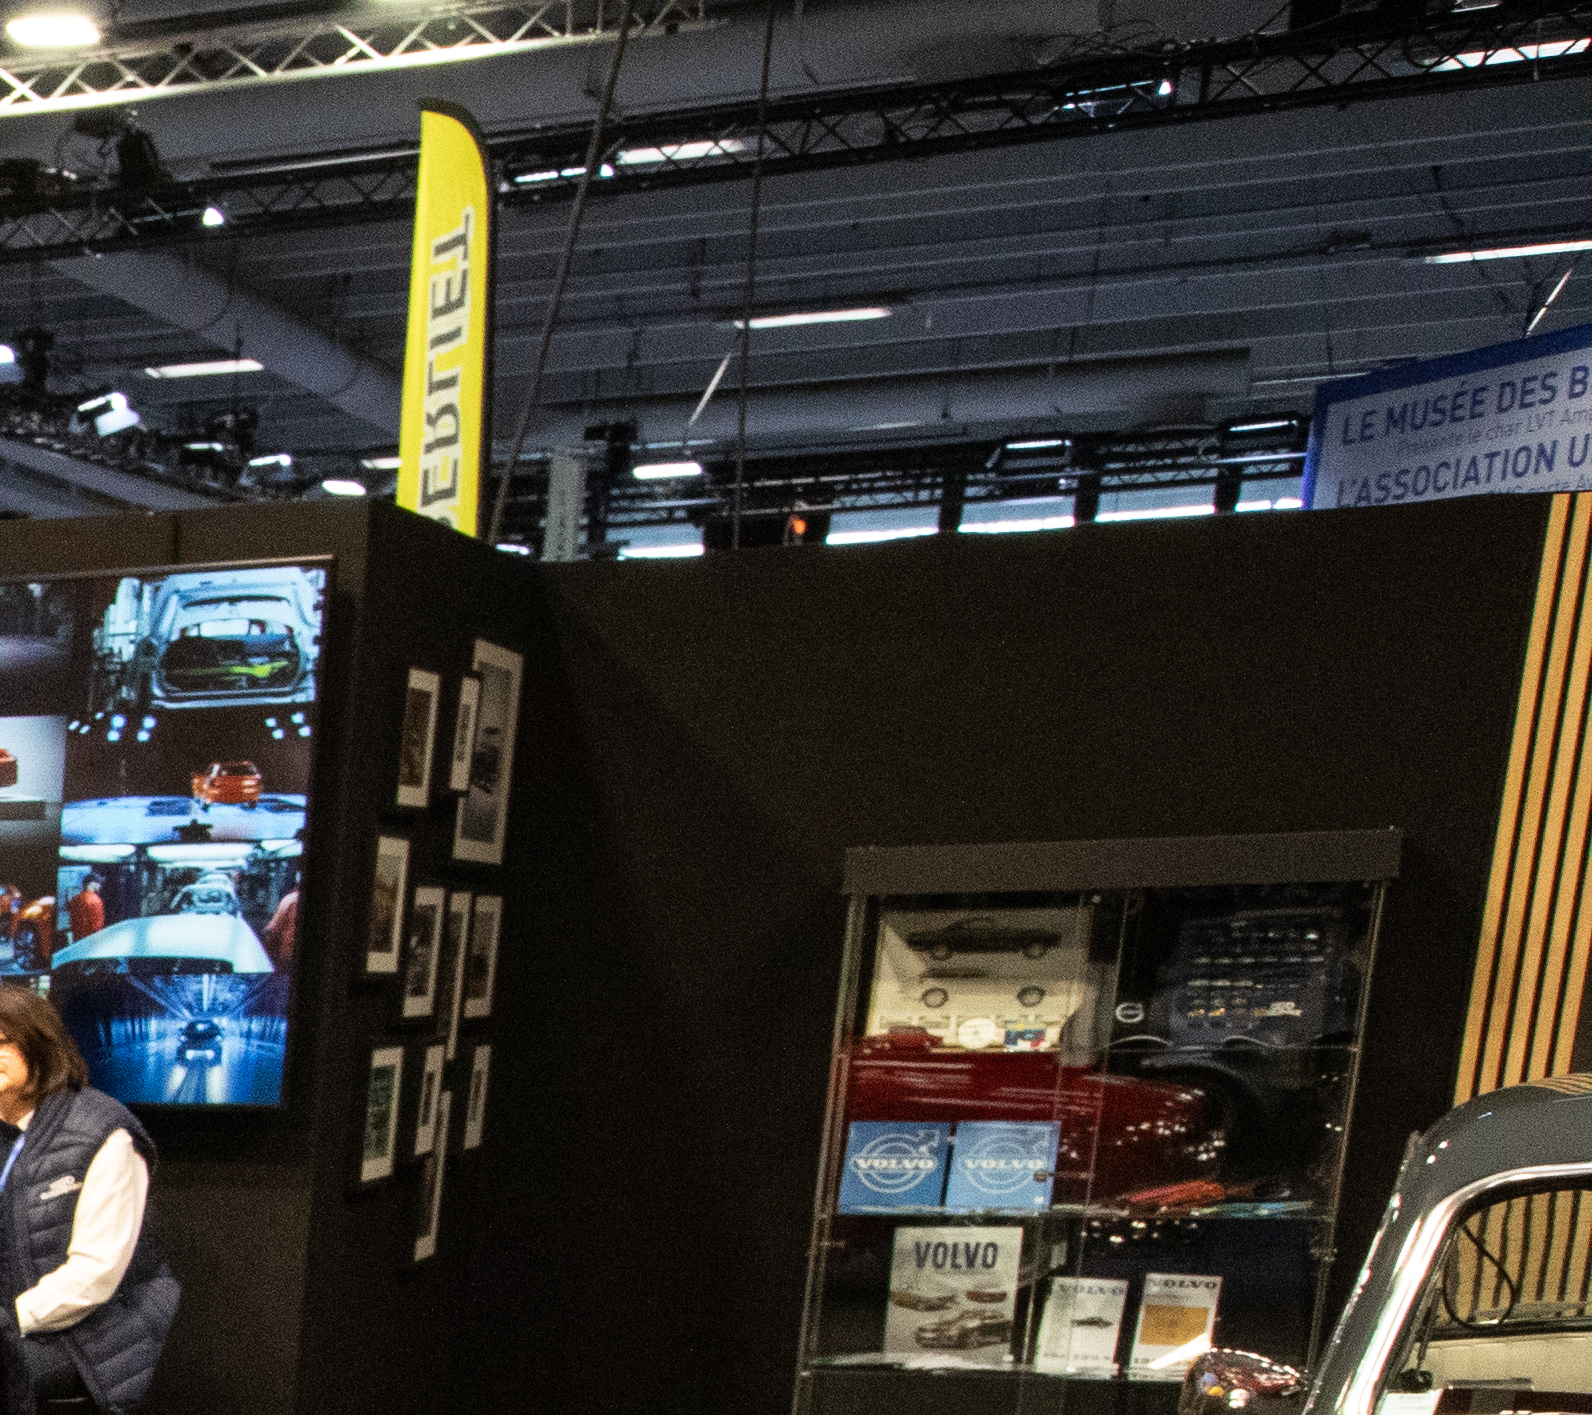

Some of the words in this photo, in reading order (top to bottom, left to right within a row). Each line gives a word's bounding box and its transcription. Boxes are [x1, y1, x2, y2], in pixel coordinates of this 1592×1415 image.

[1340, 410, 1376, 447] LE
[1383, 380, 1488, 436] MUSÉE
[1496, 371, 1558, 415] DES
[855, 1158, 934, 1169] VOLVO
[965, 1158, 1045, 1169] VOLVO
[914, 1241, 999, 1270] VOLVO
